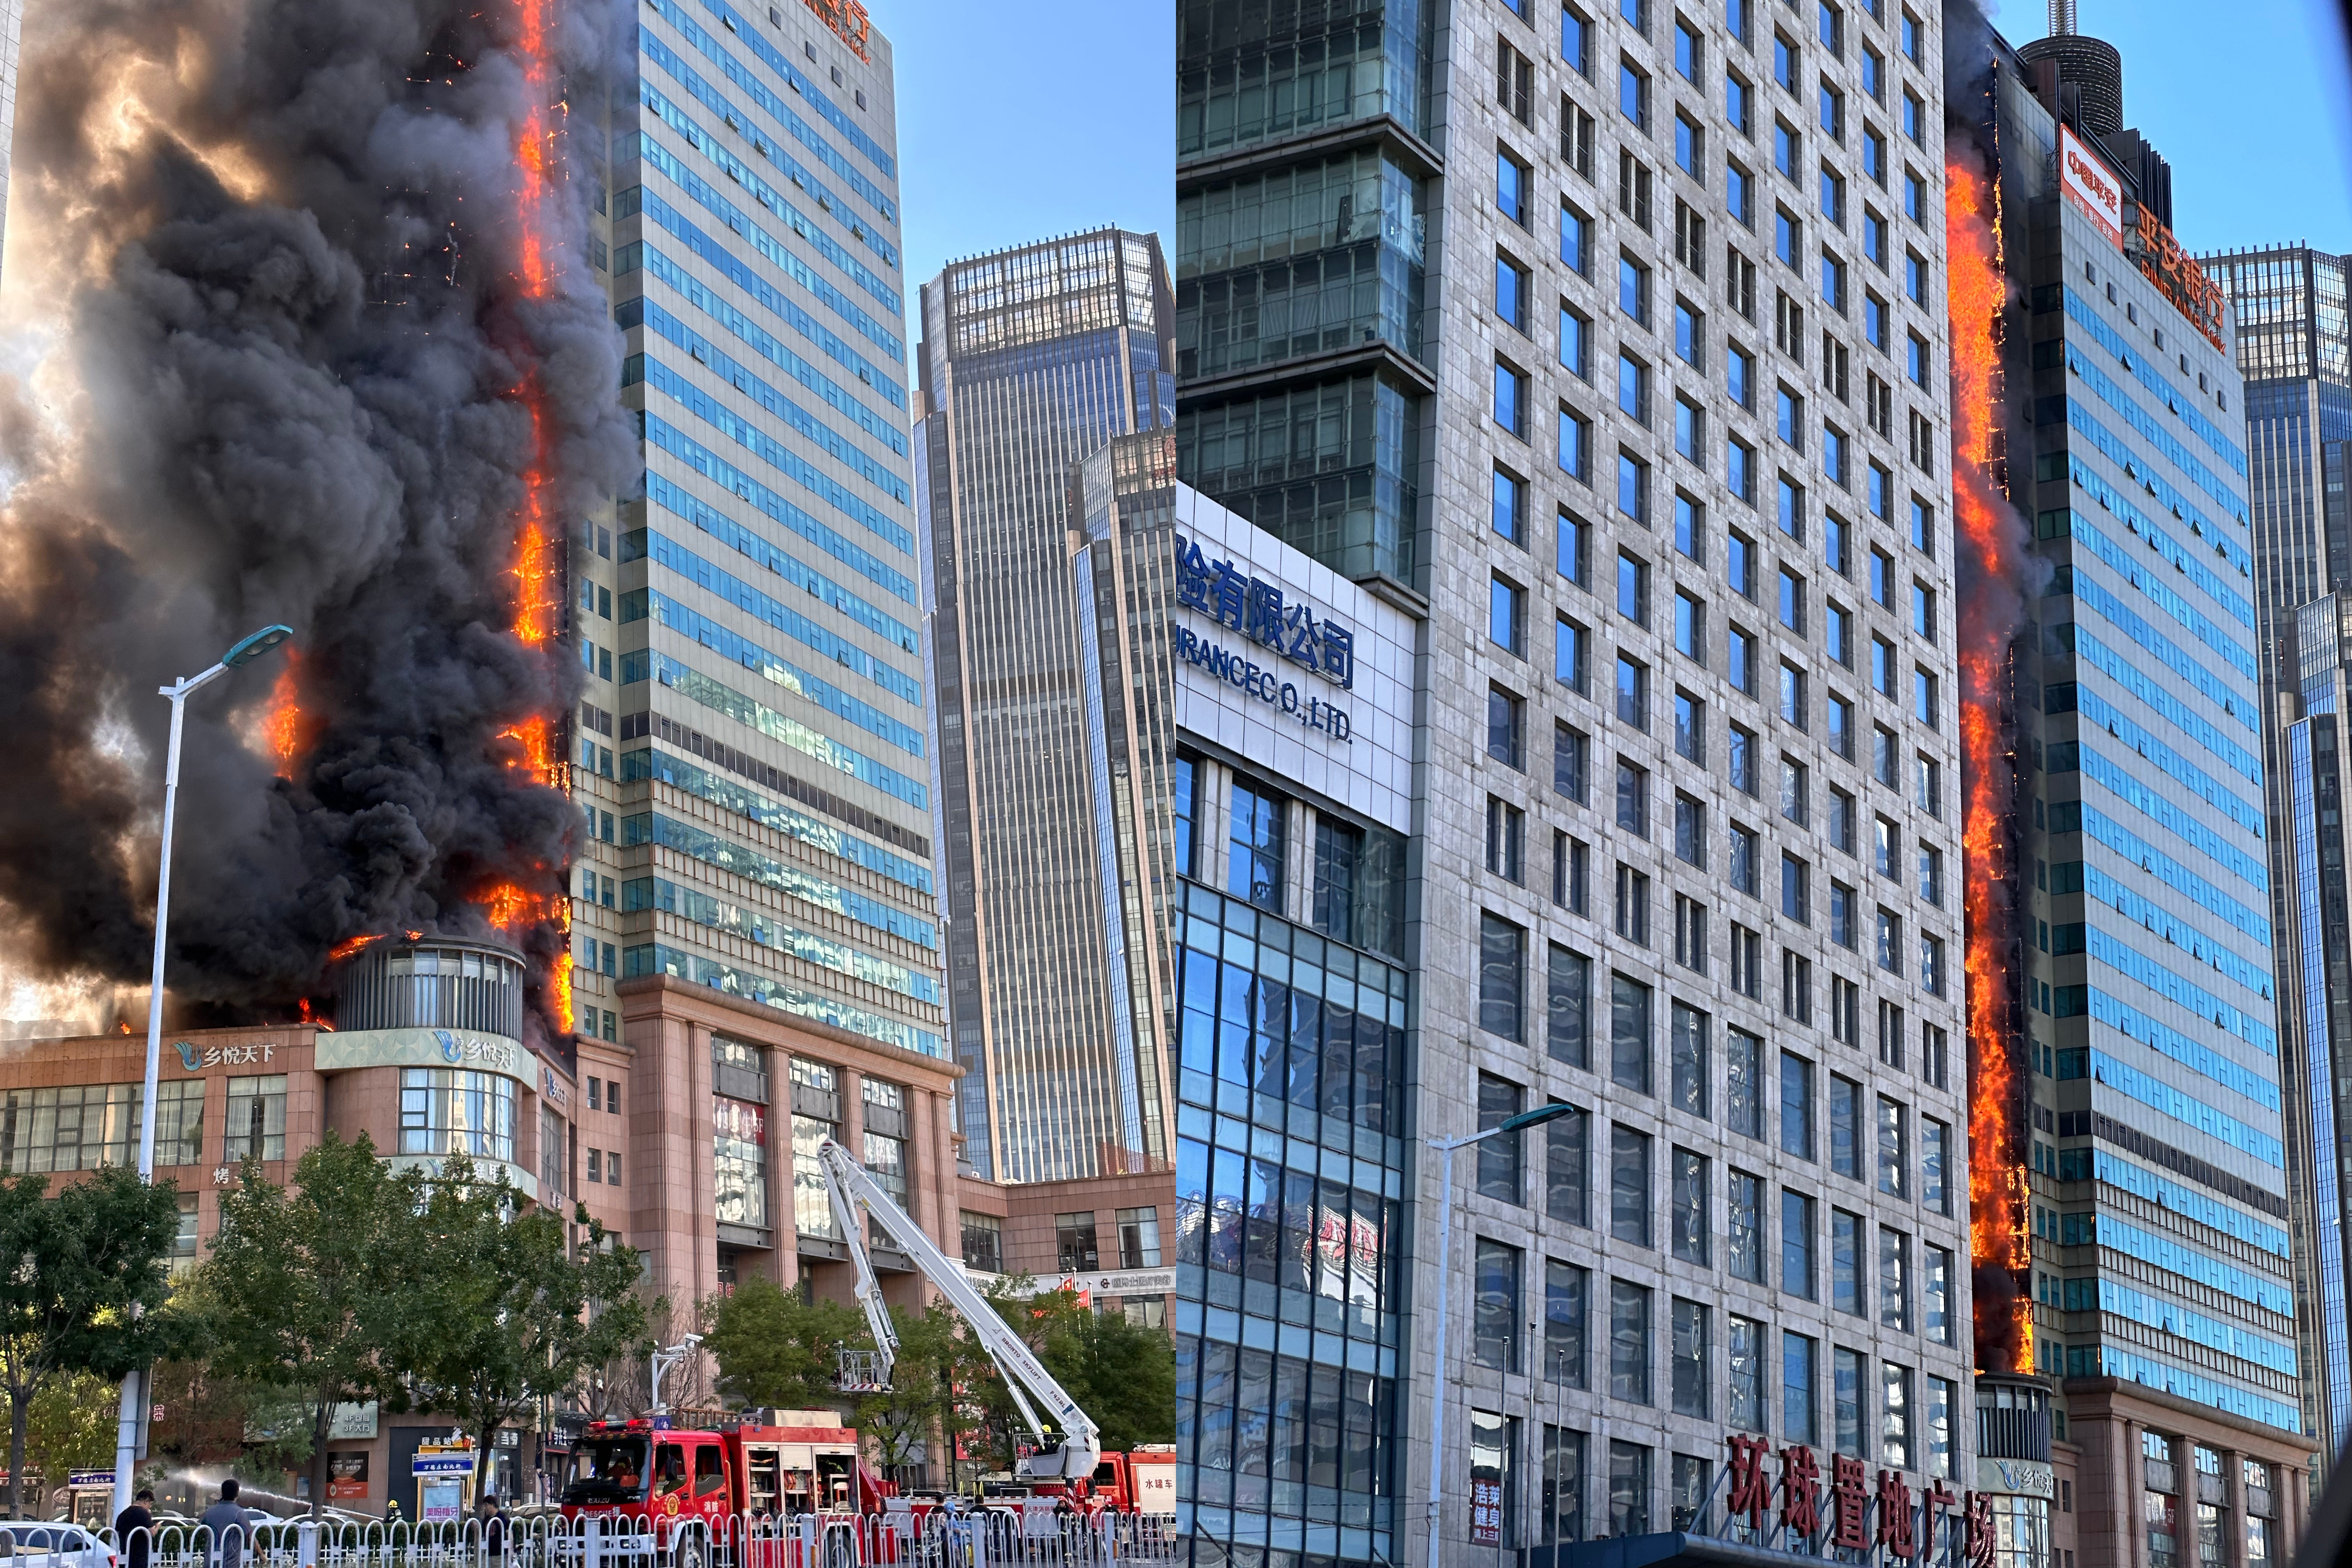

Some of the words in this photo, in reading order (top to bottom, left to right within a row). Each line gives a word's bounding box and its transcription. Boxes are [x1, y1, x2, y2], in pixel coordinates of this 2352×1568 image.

[829, 18, 871, 66] BANK
[2068, 151, 2117, 215] 中国平安
[2138, 201, 2224, 328] 平安银行
[2142, 259, 2172, 303] PING
[2175, 295, 2193, 323] AN
[2194, 313, 2226, 357] BANK
[201, 1043, 276, 1068] 乡悦天下
[465, 1038, 516, 1068] 乡悦天下
[1001, 1337, 1021, 1358] BRONTO
[1022, 1360, 1042, 1380] SKYLIFT
[1050, 1390, 1066, 1408] F42RL
[153, 1404, 164, 1421] 菜
[355, 1414, 370, 1422] 包间
[355, 1424, 370, 1432] 大厅
[422, 1437, 452, 1446] 甜品站
[1145, 1479, 1173, 1489] 水罐车
[2021, 1467, 2054, 1493] 乡悦天下
[704, 1500, 719, 1513] 消防
[1726, 1433, 1996, 1568] 环球置地广场
[1474, 1505, 1500, 1529] 健身
[2168, 1508, 2175, 1524] 5F
